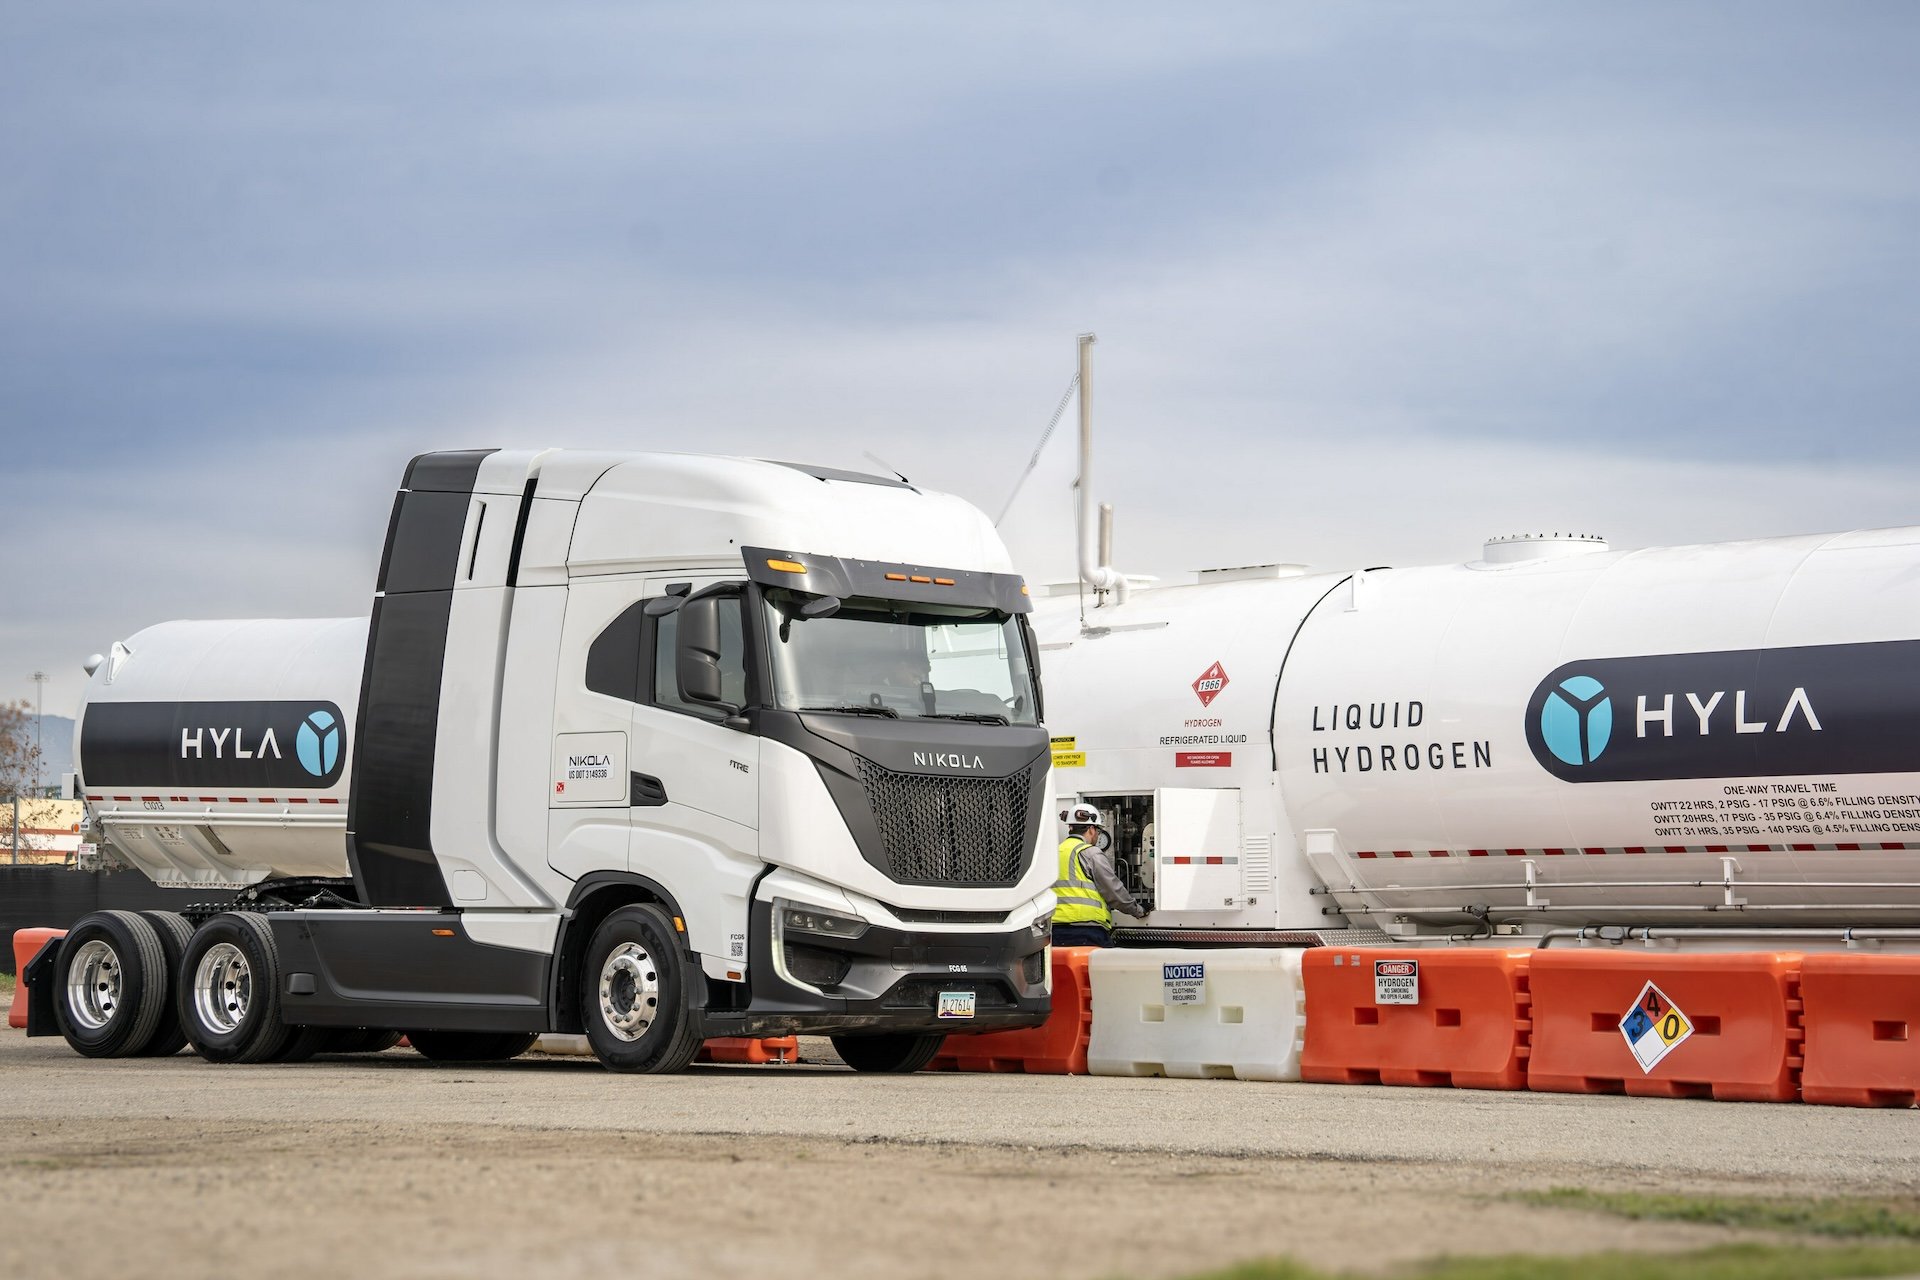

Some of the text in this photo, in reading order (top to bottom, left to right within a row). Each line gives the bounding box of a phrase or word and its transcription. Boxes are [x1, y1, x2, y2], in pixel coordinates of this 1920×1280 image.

[1200, 680, 1220, 691] 1966
[1312, 701, 1423, 731] LIQUID
[1636, 687, 1823, 738] HYLA
[1184, 719, 1222, 728] HYDROGEN
[181, 727, 282, 759] HYLA
[1159, 734, 1247, 745] REFRIGERATED LIQUID
[569, 755, 611, 767] NIKOLA
[912, 752, 984, 769] NIKOLA
[1312, 741, 1492, 773] HYDROGEN
[568, 770, 575, 780] US
[576, 770, 586, 779] DOT
[1723, 783, 1837, 795] ONE-WAY TRAVEL TIME
[143, 801, 165, 811] C1013
[1650, 801, 1677, 811] OWTT
[1679, 801, 1692, 810] 22
[1694, 800, 1718, 811] HRS,
[1720, 800, 1725, 808] 2
[1727, 799, 1750, 809] PSIG
[1758, 799, 1768, 807] 17
[1771, 798, 1795, 808] PSIG
[1798, 798, 1809, 809] @
[1810, 797, 1834, 807] 6.6%
[1836, 796, 1875, 806] FILLING
[1653, 815, 1681, 824] OWTT
[1719, 814, 1729, 822] 17
[1732, 813, 1756, 822] PSIG
[1763, 812, 1775, 821] 35
[1777, 811, 1801, 821] PSIG
[1803, 811, 1815, 822] @
[1816, 811, 1839, 820] 6.4%
[1841, 810, 1881, 819] FILLING
[1882, 809, 1920, 819] DENSIT
[1654, 827, 1682, 837] OWTT
[1684, 826, 1695, 835] 31
[1698, 826, 1722, 836] HRS,
[1722, 826, 1735, 835] 35
[1736, 825, 1760, 835] PSIG
[1768, 825, 1784, 834] 140
[1786, 824, 1811, 834] PSIG
[1812, 824, 1824, 835] @
[1825, 823, 1848, 833] 4.5%
[1850, 823, 1891, 833] FILLING
[1892, 822, 1920, 832] DENS
[1165, 966, 1203, 979] NOTICE
[1382, 964, 1409, 974] DANGER
[1378, 978, 1415, 987] HYDROGEN
[1646, 992, 1661, 1017] 4
[1631, 1011, 1645, 1038] 3
[1663, 1014, 1680, 1041] 0
